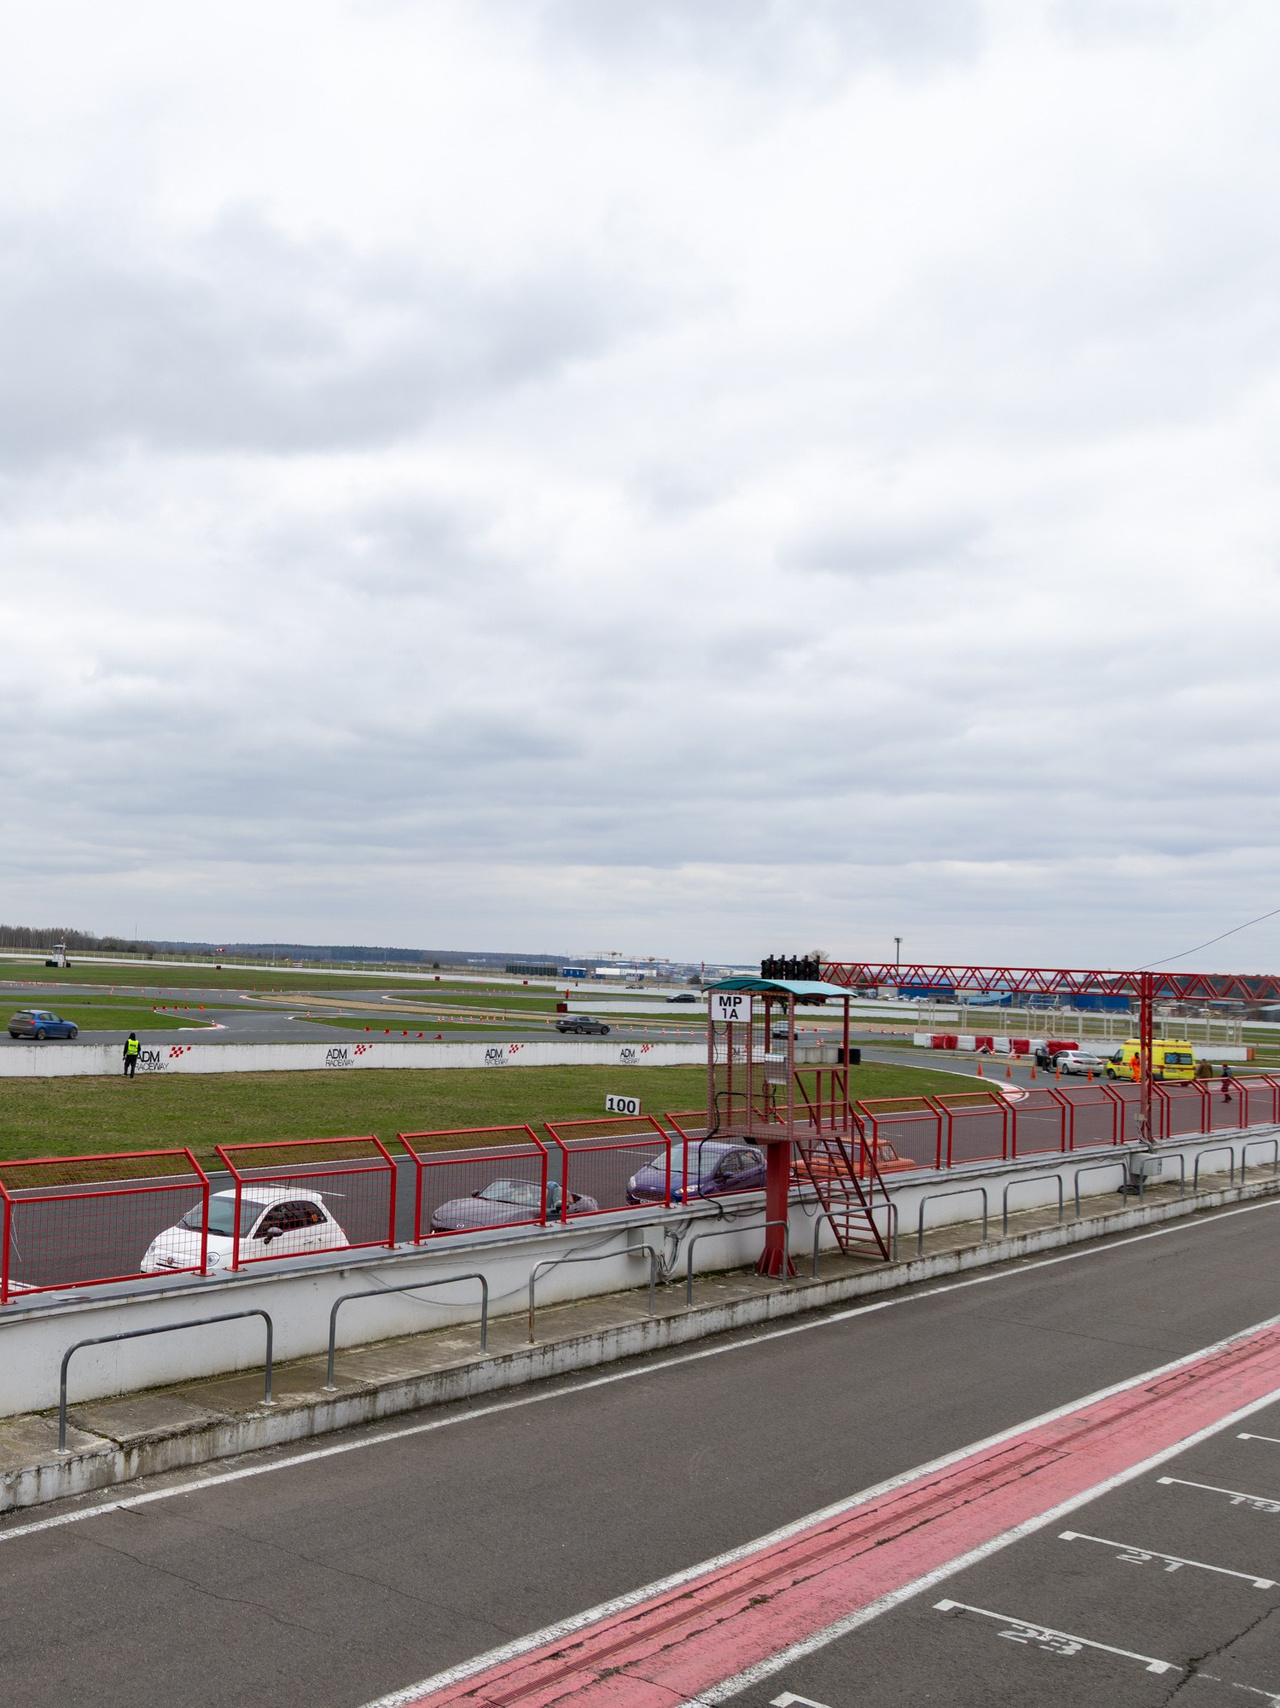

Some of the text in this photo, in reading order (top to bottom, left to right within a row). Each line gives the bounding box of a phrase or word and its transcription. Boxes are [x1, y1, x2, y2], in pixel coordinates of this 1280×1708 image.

[719, 996, 742, 1007] MP
[722, 1008, 739, 1020] 1A
[326, 1049, 349, 1059] ADM
[485, 1049, 504, 1059] ADM
[620, 1049, 636, 1058] ADM
[325, 1059, 355, 1067] RACEWAY
[607, 1097, 636, 1114] 100
[1116, 1549, 1184, 1572] 21
[997, 1624, 1083, 1655] 23
